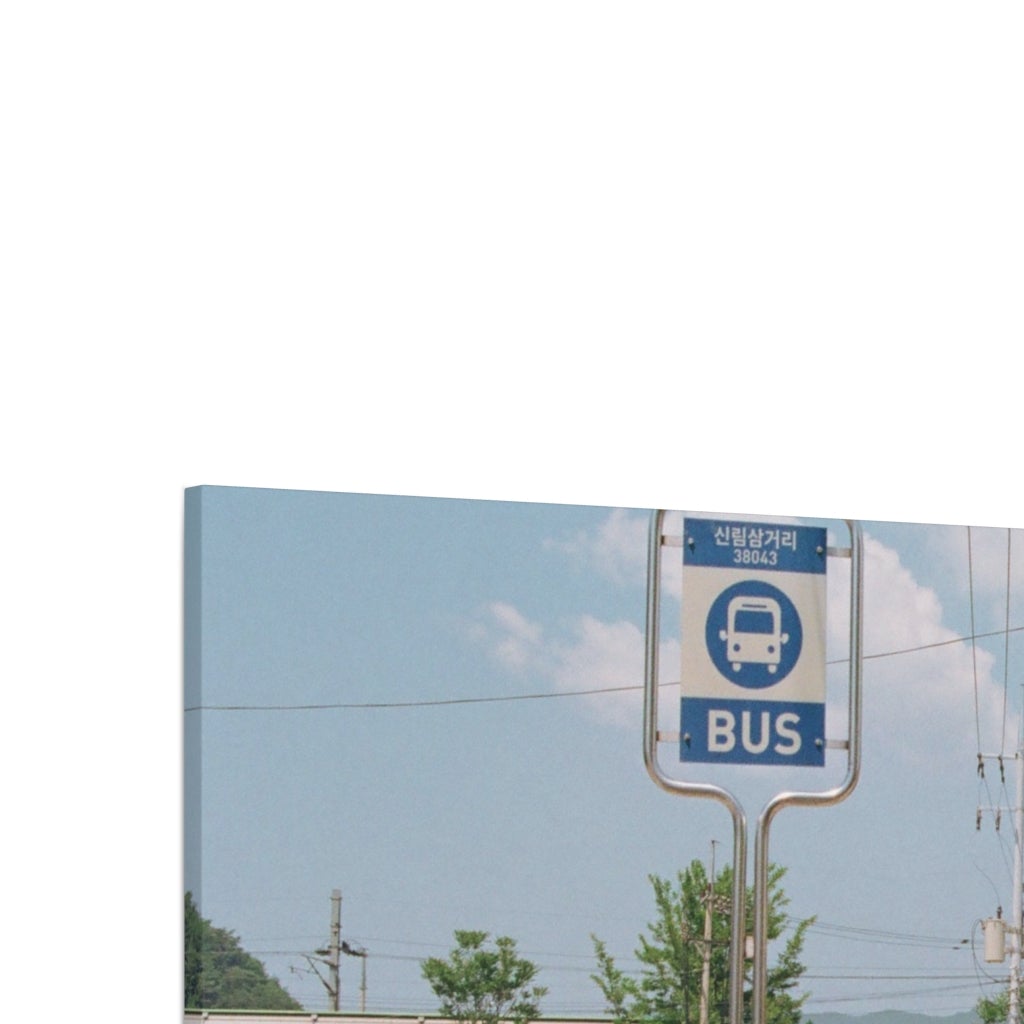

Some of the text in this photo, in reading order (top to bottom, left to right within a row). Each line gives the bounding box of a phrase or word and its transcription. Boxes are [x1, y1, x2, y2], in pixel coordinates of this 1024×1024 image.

[714, 526, 797, 550] 신림삼거리
[733, 549, 778, 565] 38043
[708, 710, 802, 756] BUS
